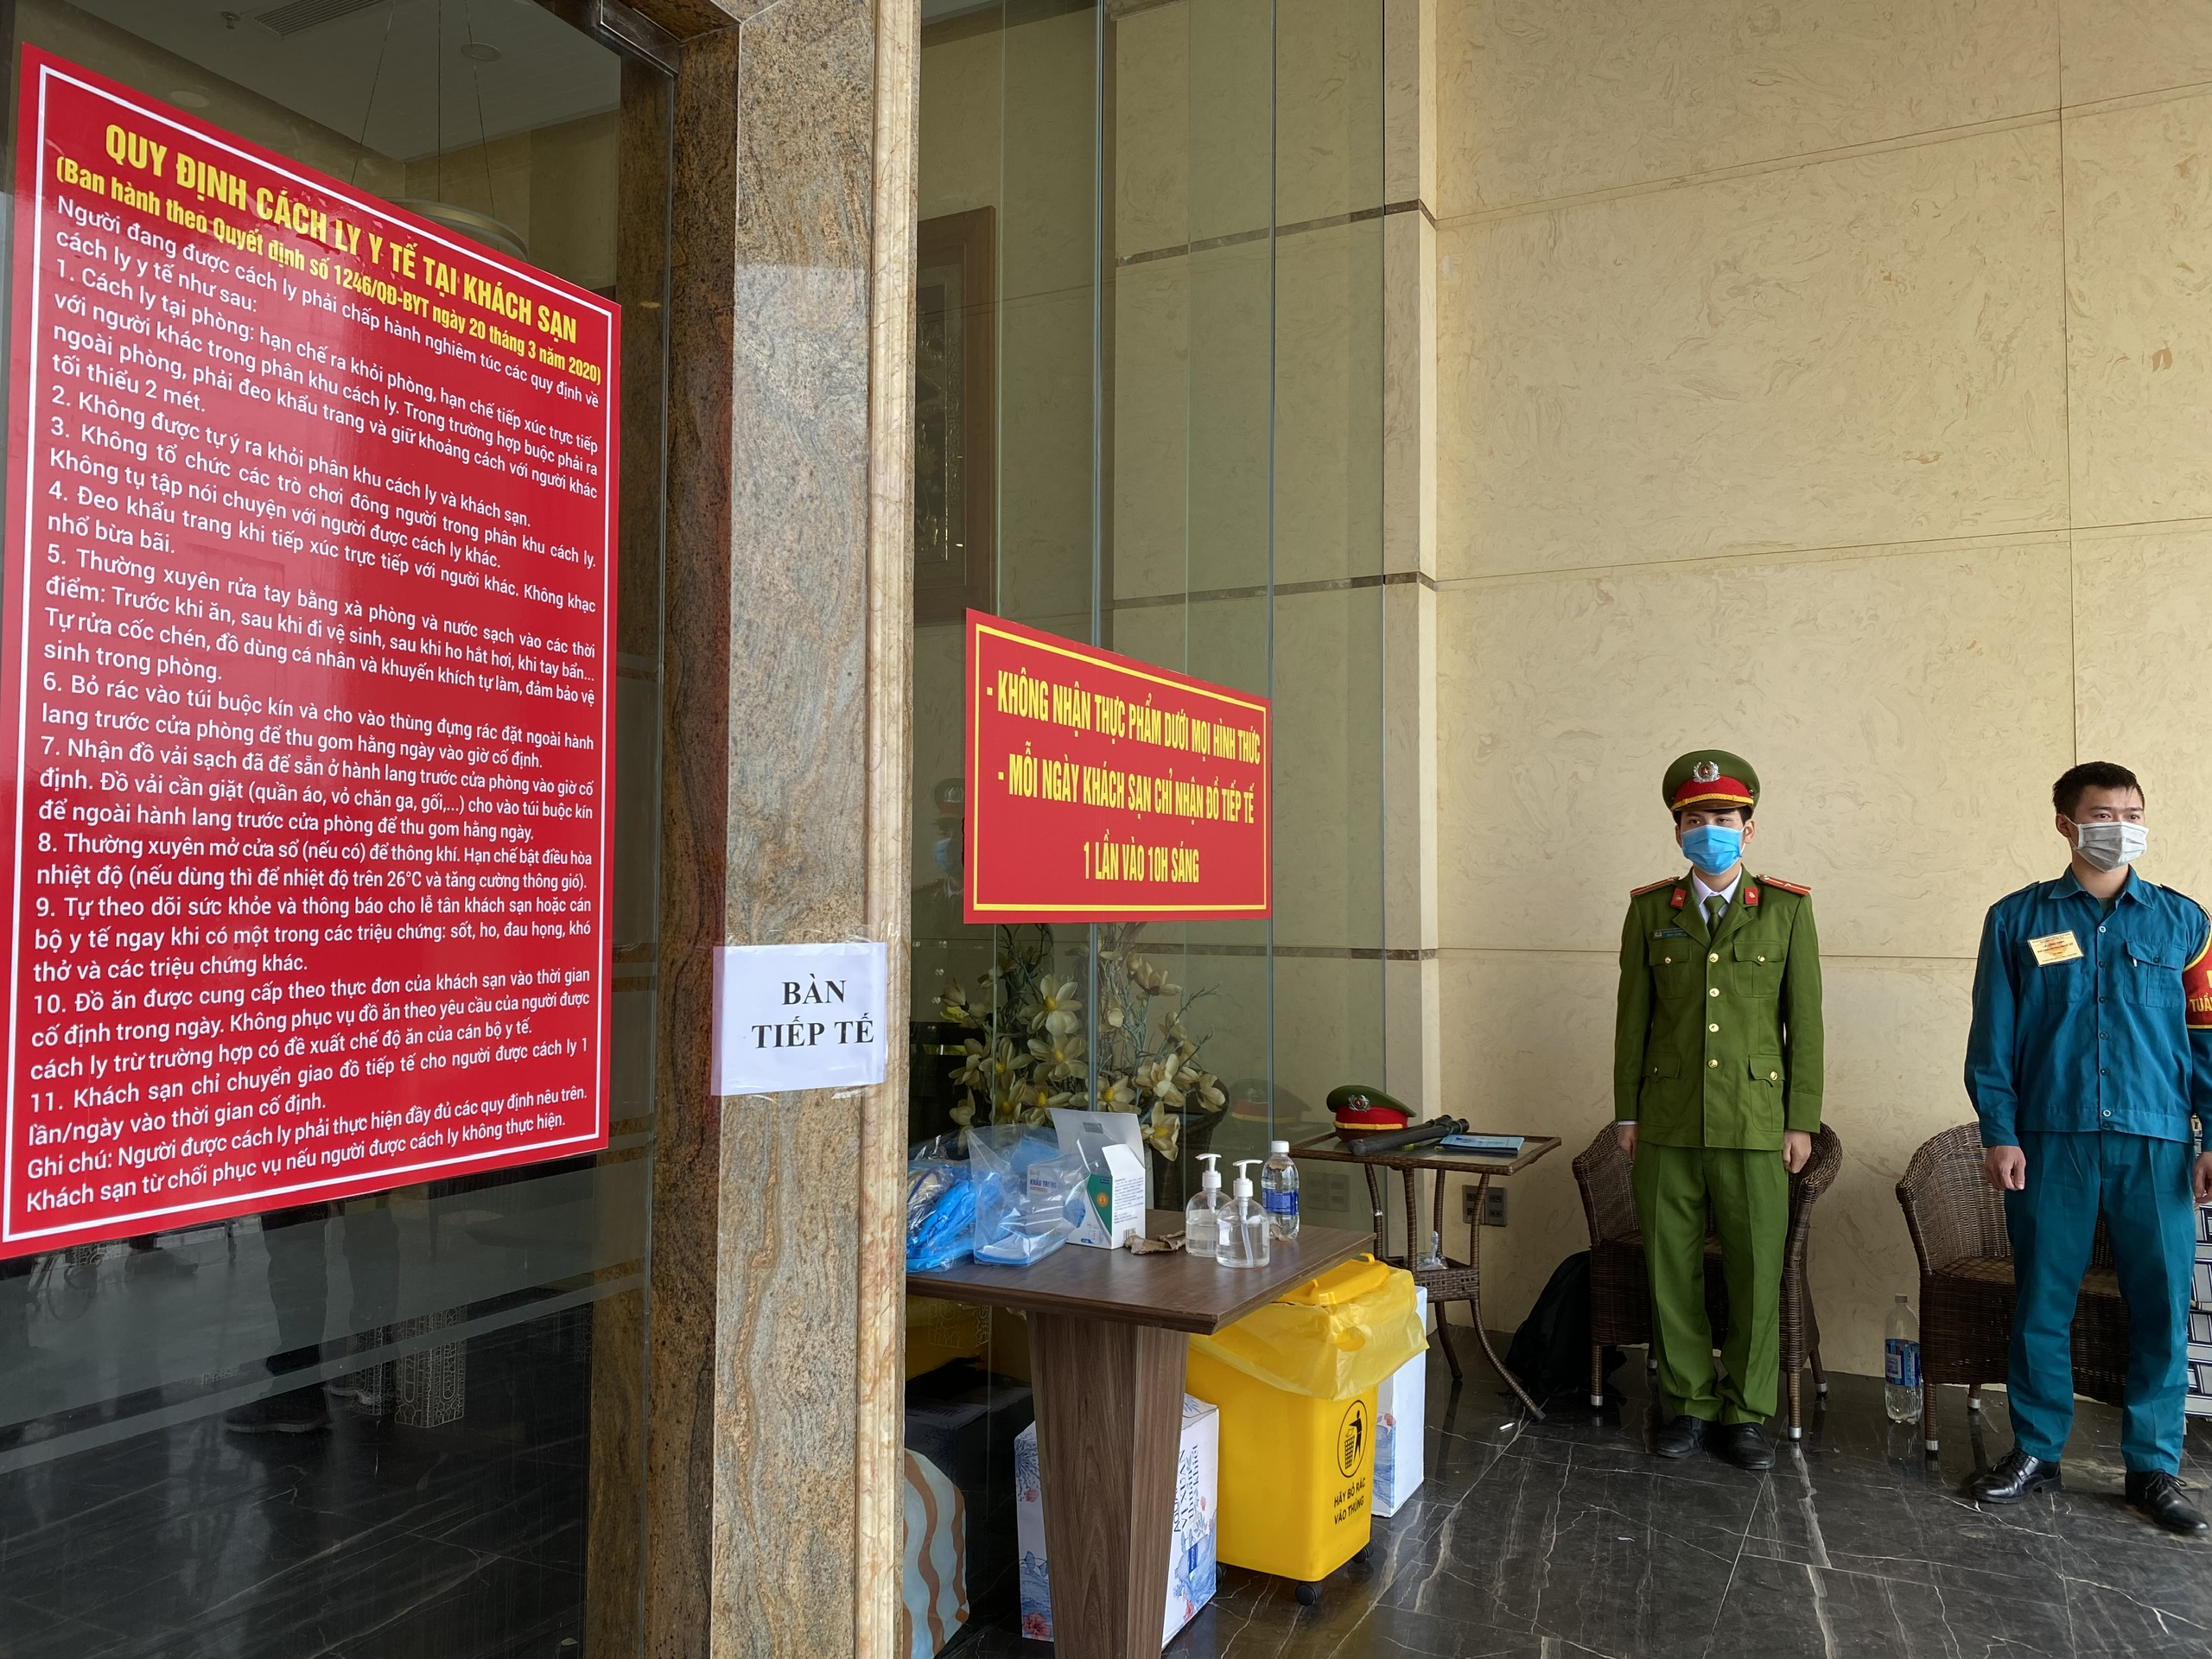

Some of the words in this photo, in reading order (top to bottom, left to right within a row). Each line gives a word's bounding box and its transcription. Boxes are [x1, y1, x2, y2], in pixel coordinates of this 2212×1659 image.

[105, 124, 168, 177] QUY
[175, 152, 247, 212] ĐỊNH
[256, 187, 327, 245] CÁCH
[334, 218, 361, 256] LY
[368, 232, 384, 264] Y
[390, 242, 418, 280] TẾ
[423, 256, 457, 298] TẠI
[463, 272, 532, 326] KHÁCH
[537, 304, 576, 344] SẠN
[56, 156, 105, 195] (Ban
[111, 176, 161, 217] hành
[165, 198, 207, 233] theo
[213, 217, 264, 256] Quyết
[268, 239, 305, 271] định
[309, 257, 331, 280] số
[334, 264, 429, 319] 1246/QĐ-BYT
[432, 305, 467, 334] ngày
[468, 317, 486, 340] 20
[488, 325, 525, 358] tháng
[528, 340, 537, 359] 3
[539, 346, 566, 371] năm
[568, 356, 601, 386] 2020)
[56, 231, 107, 261] cách
[114, 245, 131, 272] ly
[137, 258, 149, 277] y
[153, 262, 175, 283] tế
[178, 272, 217, 298] như
[219, 289, 257, 313] sau:
[58, 194, 120, 234] Người
[127, 222, 176, 259] đang
[182, 243, 230, 274] được
[235, 265, 277, 292] cách
[283, 277, 297, 302] ly
[302, 289, 337, 313] phải
[341, 302, 380, 331] chấp
[385, 315, 421, 344] hành
[425, 334, 476, 364] nghiêm
[480, 353, 501, 372] túc
[505, 364, 528, 382] các
[531, 374, 554, 394] quy
[556, 380, 582, 402] định
[585, 391, 599, 408] về
[52, 385, 71, 407] 2.
[79, 391, 145, 430] Không
[151, 411, 200, 441] được
[205, 427, 227, 449] tự
[229, 433, 240, 454] ý
[245, 440, 262, 457] ra
[268, 441, 303, 467] khỏi
[308, 455, 348, 480] phân
[353, 464, 381, 487] khu
[385, 477, 421, 499] cách
[424, 483, 437, 505] ly
[441, 491, 456, 508] và
[461, 493, 501, 519] khách
[504, 510, 531, 527] sạn.
[48, 512, 90, 537] nhổ
[95, 519, 133, 546] bừa
[140, 529, 175, 554] bãi.
[43, 639, 90, 663] sinh
[96, 647, 150, 676] trong
[157, 655, 222, 683] phòng.
[42, 702, 88, 731] lang
[94, 710, 149, 732] trước
[156, 715, 191, 736] cửa
[196, 719, 254, 746] phòng
[259, 724, 283, 744] để
[285, 728, 313, 747] thu
[317, 735, 353, 753] gom
[358, 734, 396, 759] hằng
[400, 741, 435, 762] ngày
[438, 744, 464, 761] vào
[467, 747, 490, 766] giờ
[492, 748, 509, 765] cố
[511, 750, 543, 769] định.
[997, 666, 1049, 723] KHÔNG
[1052, 680, 1091, 738] NHẬN
[1094, 694, 1126, 746] THỰC
[1128, 691, 1162, 745] PHẨM
[1164, 708, 1189, 752] DƯỚI
[1191, 716, 1212, 762] MỌI
[1212, 717, 1236, 761] HÌNH
[1236, 724, 1262, 766] THỨC
[1007, 740, 1039, 798] MỖI
[1041, 753, 1080, 802] NGÀY
[1082, 760, 1125, 810] KHÁCH
[1127, 775, 1152, 820] SẠN
[1154, 766, 1173, 817] CHỈ
[1174, 778, 1205, 826] NHẬN
[1205, 774, 1220, 822] ĐỒ
[1221, 778, 1242, 824] TIẾP
[1243, 781, 1255, 825] TẾ
[37, 863, 91, 888] nhiệt
[97, 865, 124, 889] độ
[129, 864, 172, 890] (nếu
[177, 866, 225, 890] dùng
[229, 867, 252, 886] thì
[257, 866, 280, 887] để
[283, 868, 325, 890] nhiệt
[328, 868, 349, 890] độ
[352, 869, 383, 887] trên
[387, 870, 422, 887] 26°C
[425, 871, 442, 887] và
[445, 871, 476, 892] tăng
[479, 872, 519, 892] cường
[522, 872, 558, 892] thông
[561, 873, 587, 892] gió).
[1083, 840, 1090, 880] 1
[1094, 828, 1120, 882] LẦN
[1122, 836, 1146, 882] VÀO
[1147, 845, 1169, 883] 10H
[1170, 837, 1200, 884] SÁNG
[781, 973, 847, 1006] BÀN
[2190, 993, 2212, 1012] TUẦ
[751, 1015, 825, 1049] TIẾP
[834, 1013, 874, 1044] TẾ
[29, 1117, 124, 1147] lần/ngày
[130, 1112, 166, 1133] vào
[171, 1104, 208, 1128] thời
[214, 1102, 253, 1127] gian
[258, 1094, 282, 1116] cố
[284, 1091, 326, 1116] định.
[27, 1183, 94, 1212] Khách
[100, 1181, 137, 1203] sạn
[142, 1173, 165, 1194] từ
[168, 1163, 207, 1189] chối
[213, 1161, 257, 1186] phục
[261, 1159, 282, 1176] vụ
[286, 1147, 316, 1171] nếu
[321, 1141, 365, 1167] người
[369, 1138, 406, 1157] được
[410, 1129, 443, 1150] cách
[447, 1128, 459, 1147] ly
[462, 1122, 503, 1141] không
[505, 1117, 534, 1135] thực
[537, 1112, 565, 1131] hiện.
[1334, 1509, 1347, 1525] VÀO
